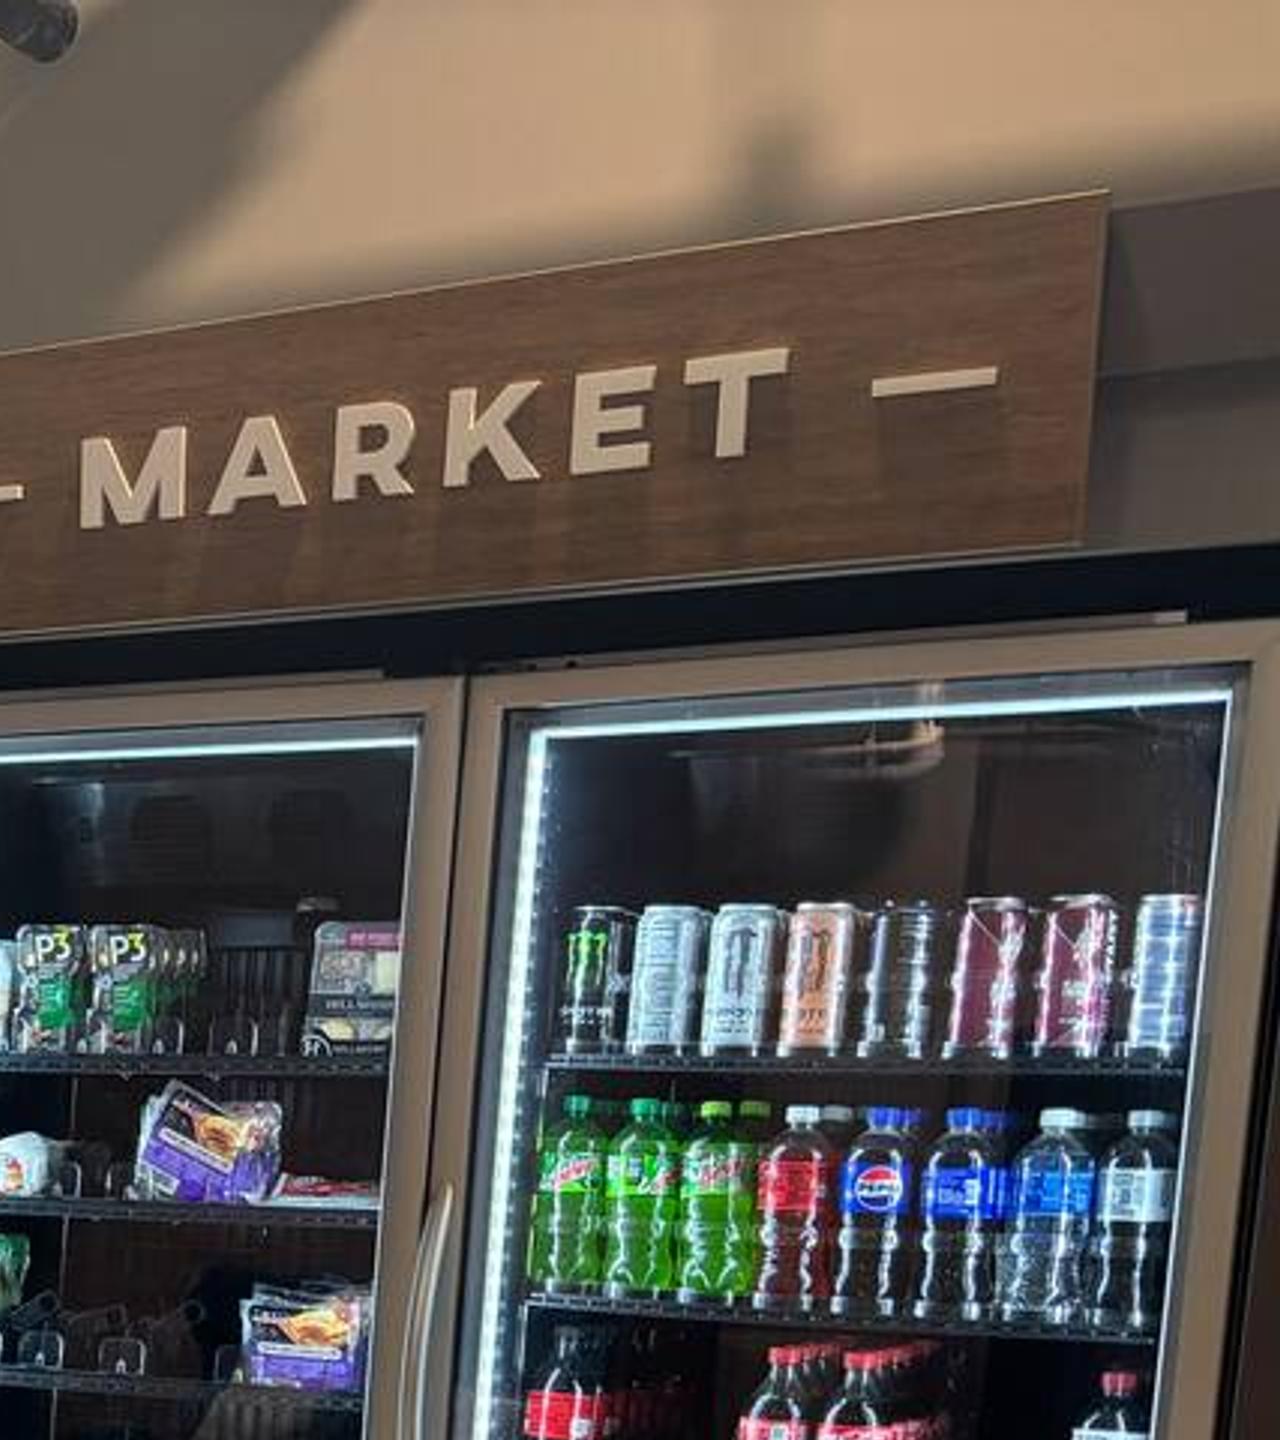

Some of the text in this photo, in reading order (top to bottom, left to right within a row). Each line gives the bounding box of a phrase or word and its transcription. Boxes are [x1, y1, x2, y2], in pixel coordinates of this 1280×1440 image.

[79, 347, 789, 528] MARKET
[35, 932, 72, 961] P3
[110, 932, 146, 964] P3
